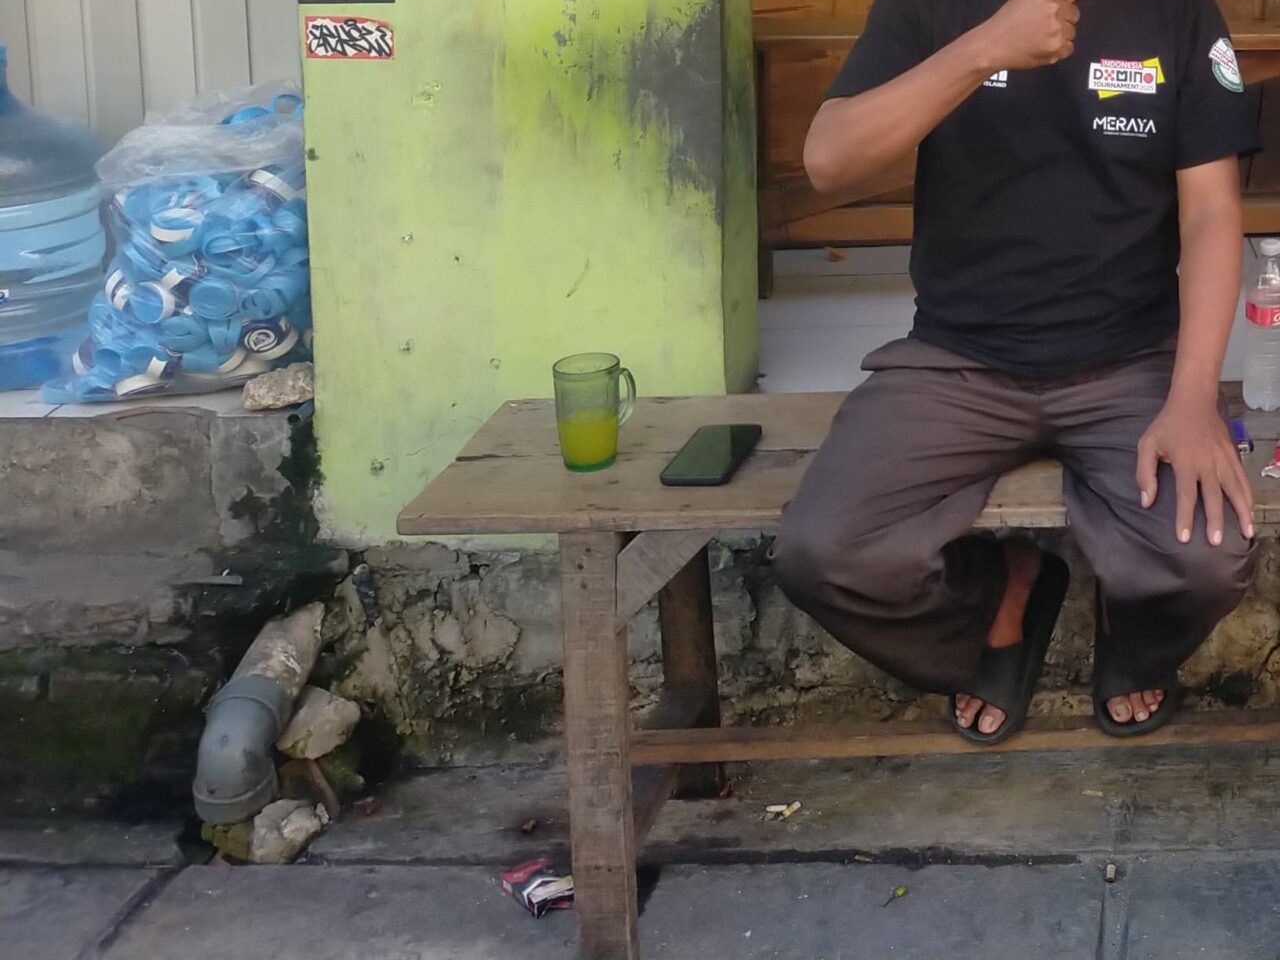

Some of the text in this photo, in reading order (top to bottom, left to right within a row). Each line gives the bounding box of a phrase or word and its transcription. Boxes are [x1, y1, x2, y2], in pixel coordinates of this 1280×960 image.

[1101, 59, 1143, 69] INDONESIA
[1093, 81, 1139, 90] TOURNAMENT
[1093, 116, 1157, 134] MERAYA
